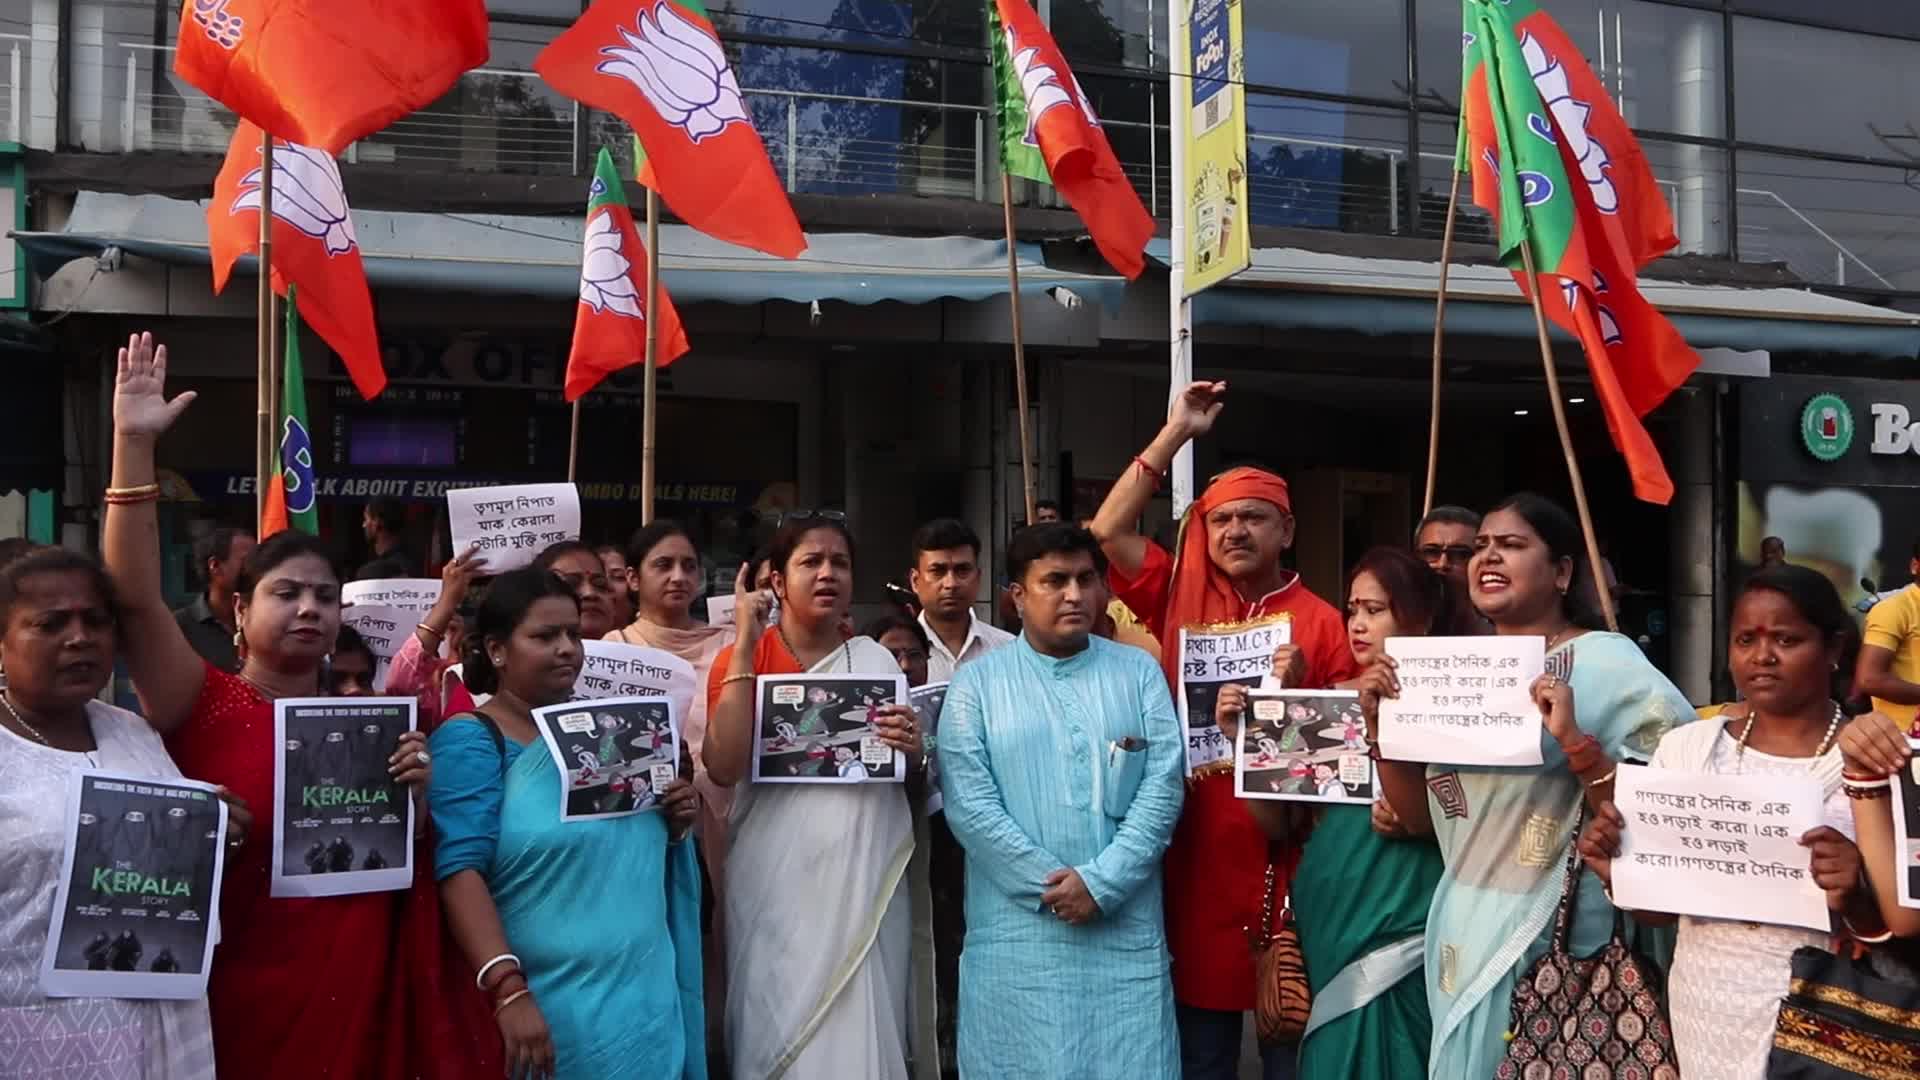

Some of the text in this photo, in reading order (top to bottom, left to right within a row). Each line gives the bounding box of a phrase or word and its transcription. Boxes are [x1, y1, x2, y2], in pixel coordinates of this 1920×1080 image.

[474, 496, 556, 516] তৃণমূল নিপাত
[477, 518, 505, 531] যাক
[510, 531, 539, 549] মুক্তি
[540, 530, 567, 543] পাক
[360, 615, 398, 631] নিপাত
[584, 655, 673, 680] তৃণমূল নিপাত
[1451, 654, 1491, 669] সৈনিক
[584, 675, 613, 690] যাক
[1401, 676, 1418, 688] হও
[1421, 673, 1452, 689] লড়াই
[1457, 676, 1487, 688] করো
[1432, 692, 1484, 708] হও লড়াই
[1482, 711, 1524, 727] সৈনিক
[302, 786, 389, 808] KERALA
[1635, 789, 1696, 810] গণতন্ত্রের
[1699, 793, 1752, 813] সৈনিক
[345, 805, 371, 814] STORY
[1637, 810, 1659, 826] হও
[1662, 812, 1703, 832] লড়াই
[1709, 819, 1748, 835] করো
[1680, 835, 1749, 855] হও লড়াই
[1751, 860, 1805, 880] সৈনিক
[91, 867, 192, 897] KERALA
[141, 895, 170, 905] STORY
